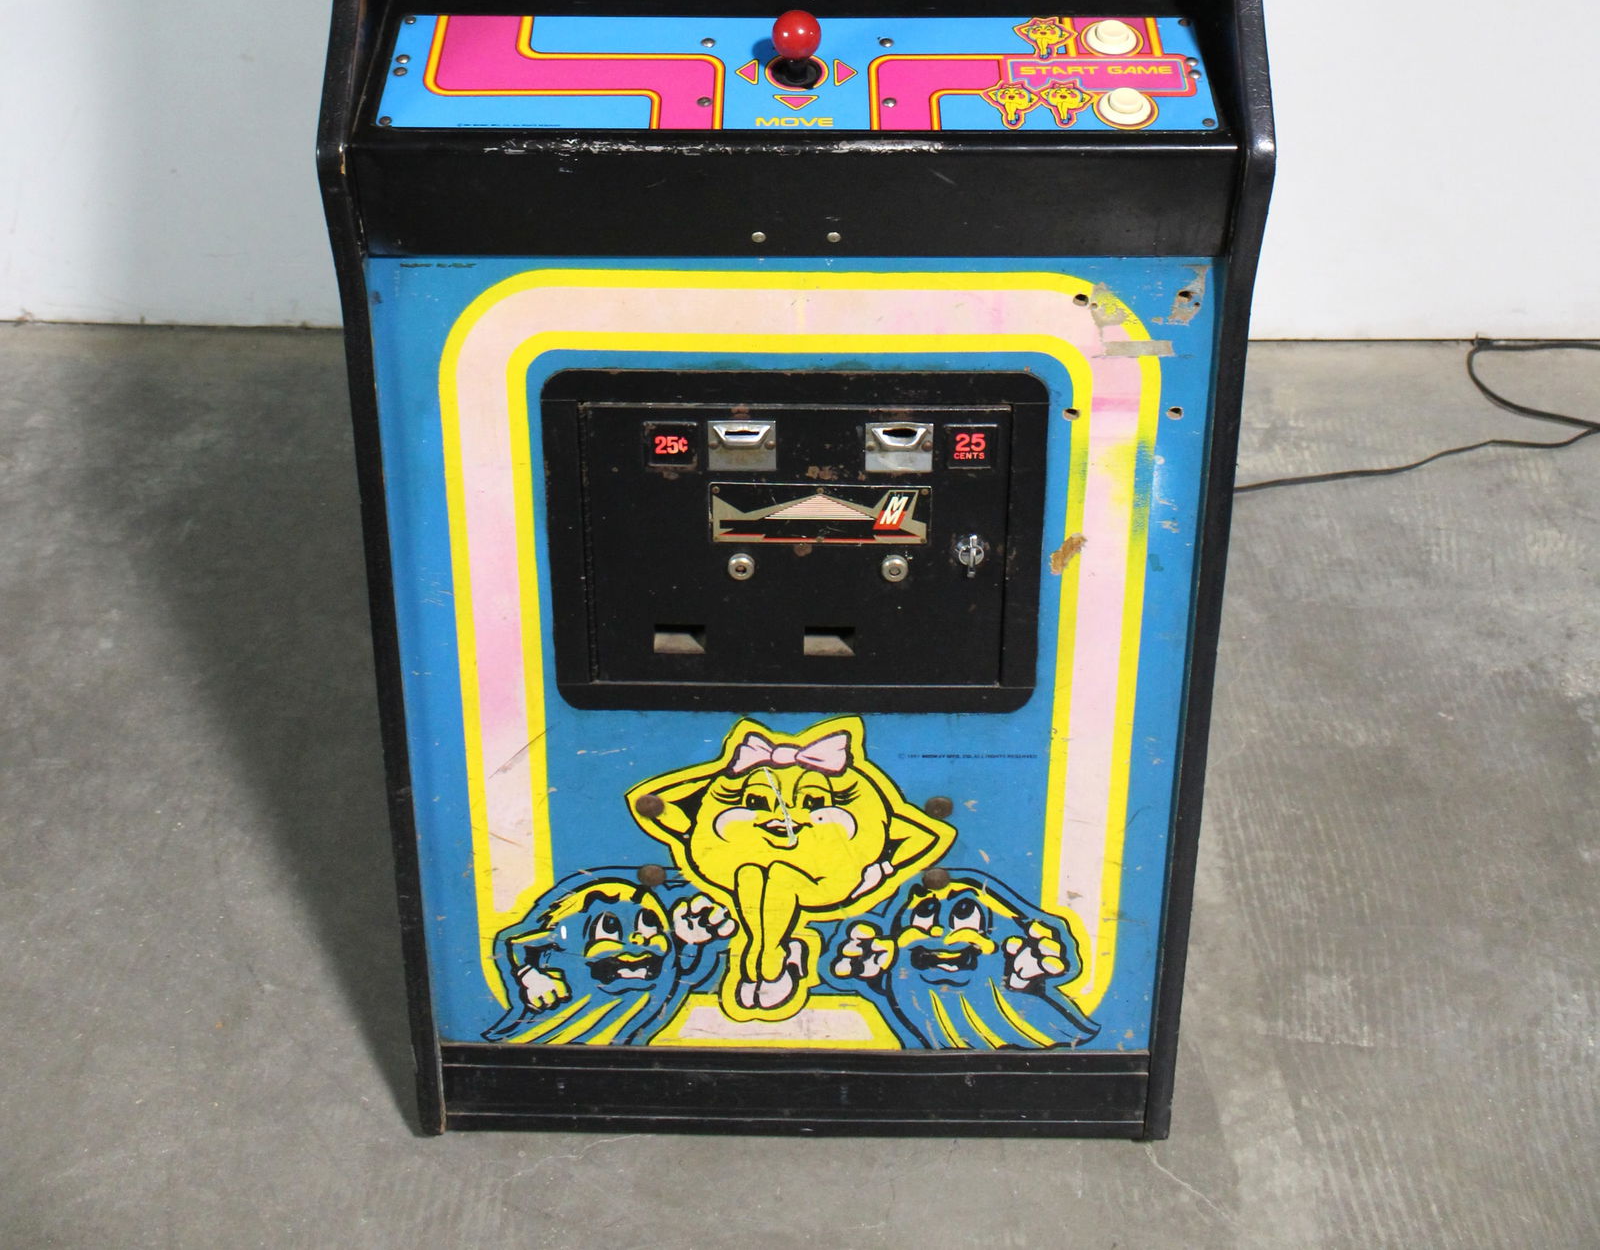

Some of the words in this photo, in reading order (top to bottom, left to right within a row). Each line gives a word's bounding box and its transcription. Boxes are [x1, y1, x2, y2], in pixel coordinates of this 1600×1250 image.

[1019, 65, 1097, 75] START
[1107, 65, 1173, 75] GAME
[755, 117, 833, 127] MOVE
[654, 436, 688, 455] 25¢
[955, 433, 986, 452] 25
[954, 452, 985, 460] CENTS
